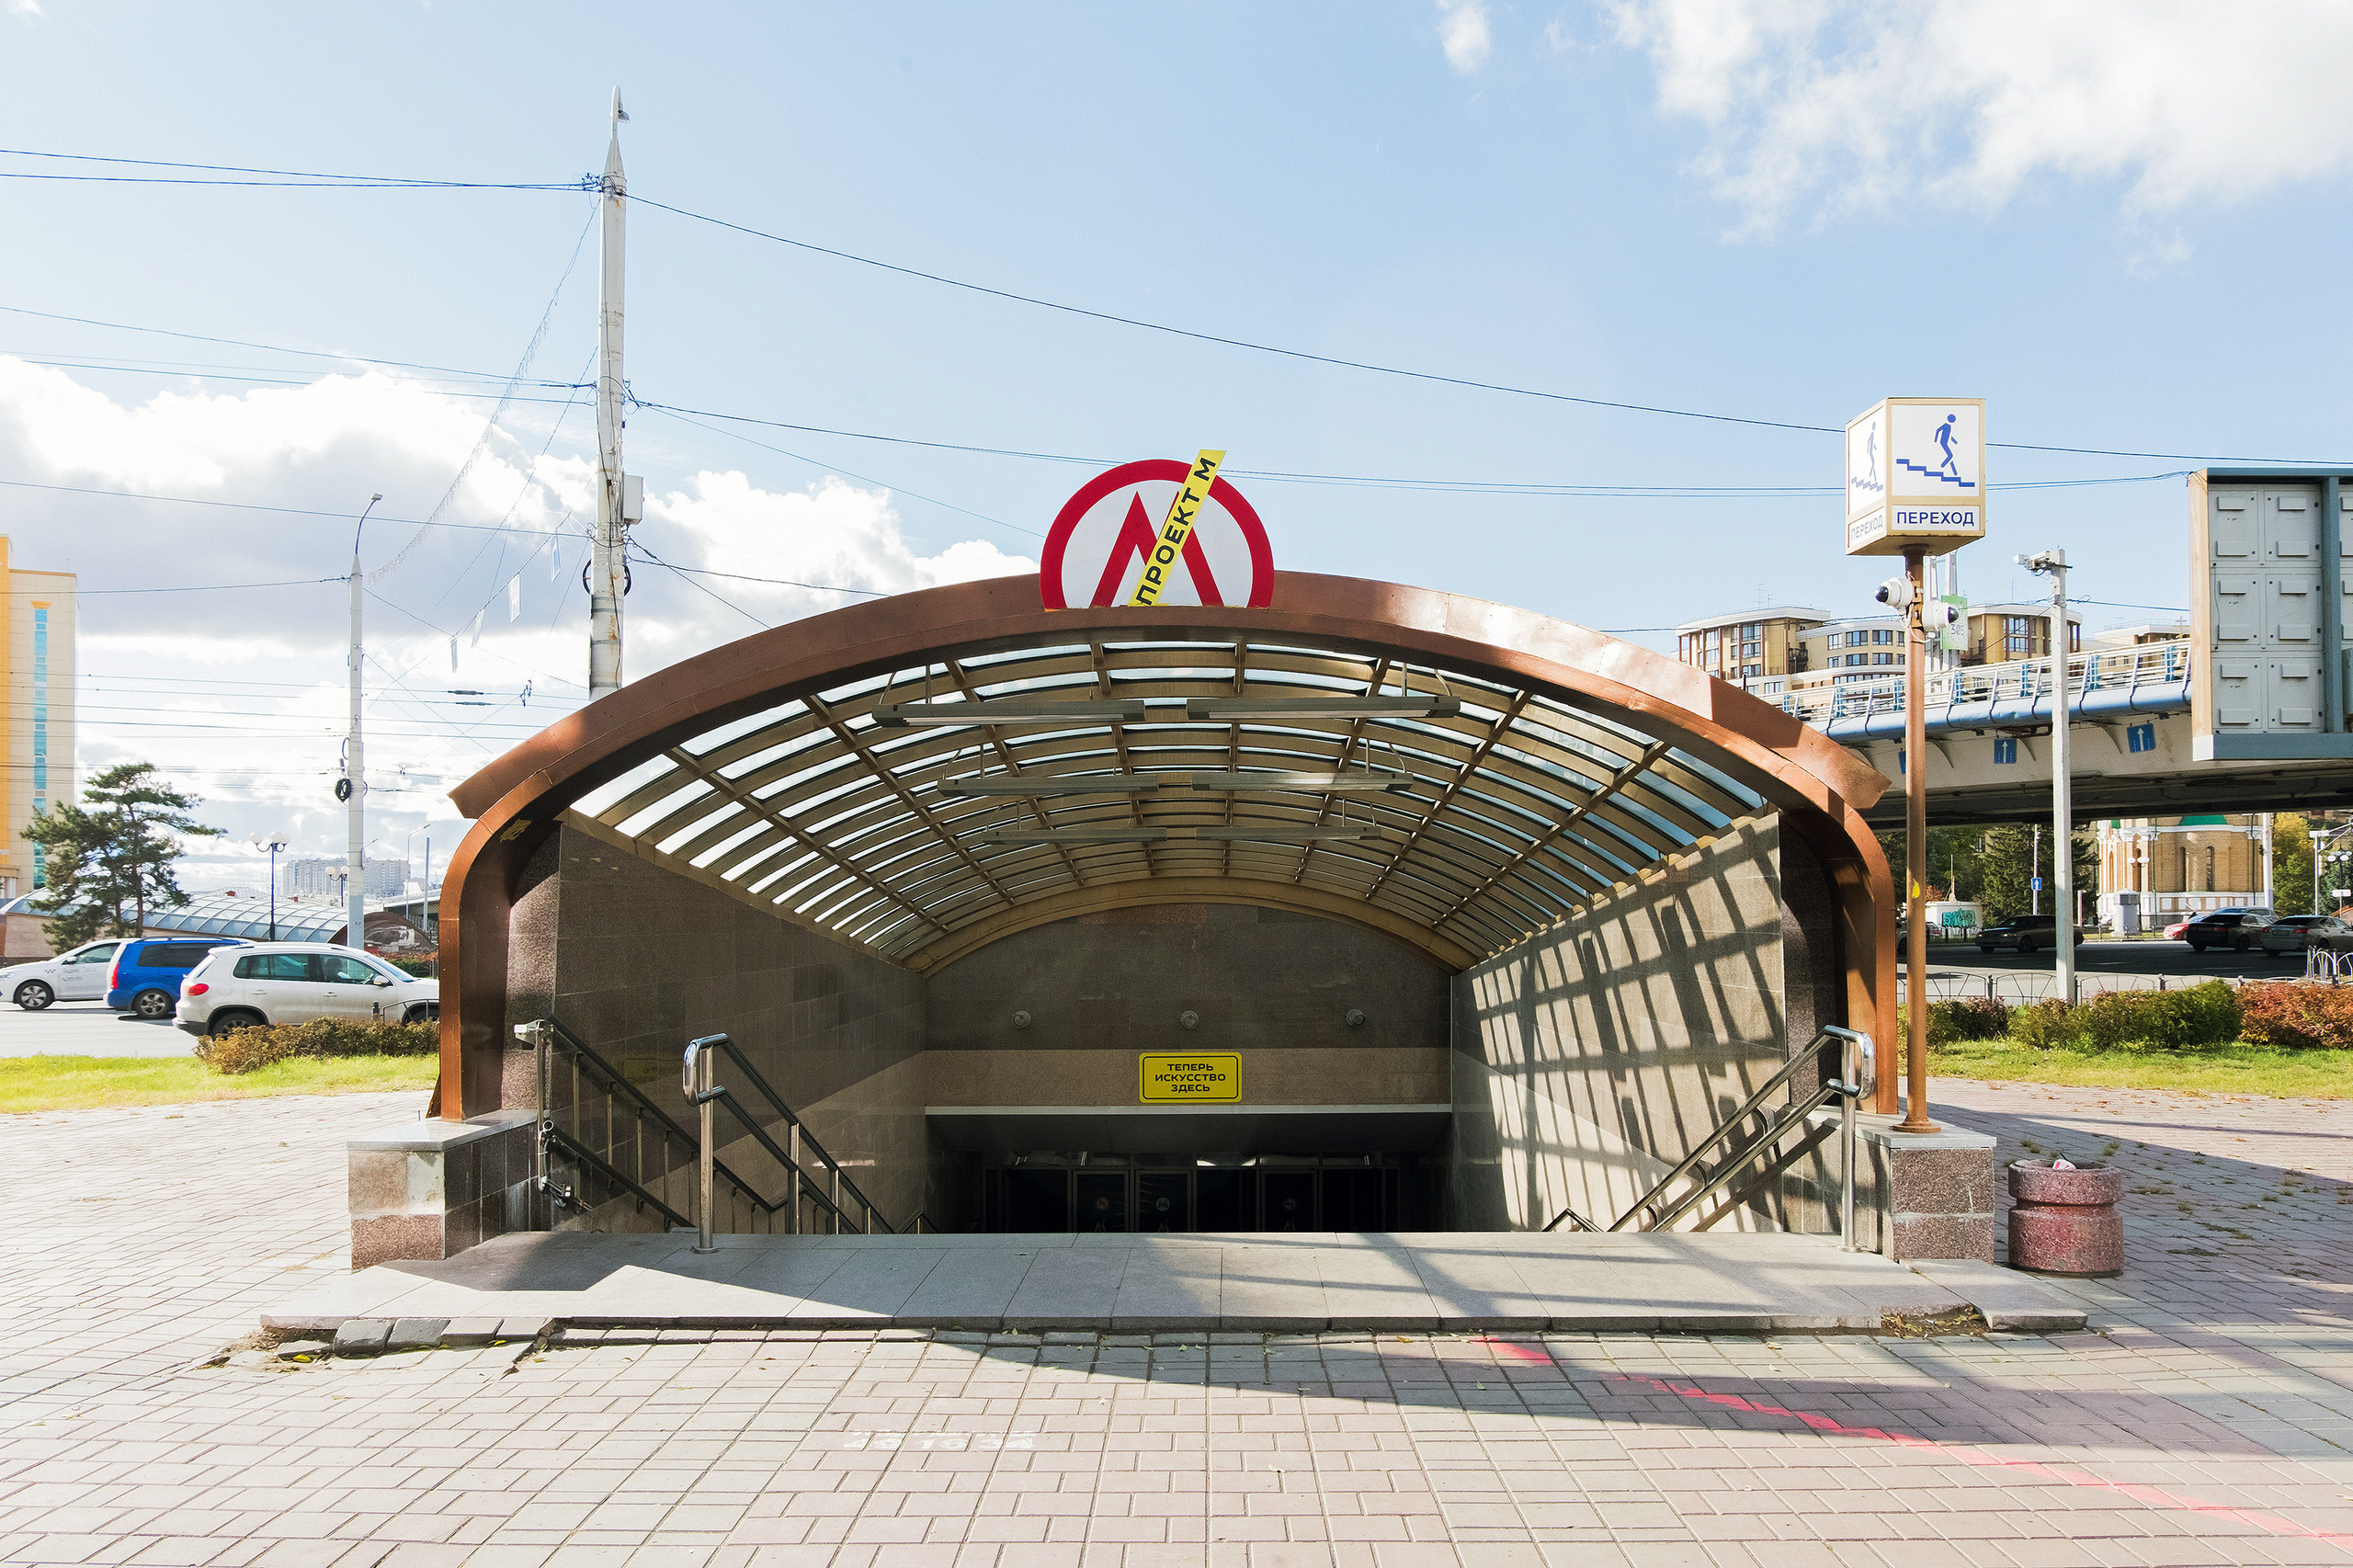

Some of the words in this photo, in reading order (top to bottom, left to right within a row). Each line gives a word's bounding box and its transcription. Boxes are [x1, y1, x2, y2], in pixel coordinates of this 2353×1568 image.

[1896, 511, 1975, 527] ПЕРЕХОД
[1135, 486, 1200, 606] ПРОЕКТ
[1193, 457, 1216, 482] М
[1850, 514, 1884, 541] ПЕРЕХОД
[1166, 1063, 1214, 1072] ТЕПЕРЬ
[1154, 1073, 1227, 1082] ИСКУССТВО
[1170, 1084, 1211, 1094] ЗДЕСЬ
